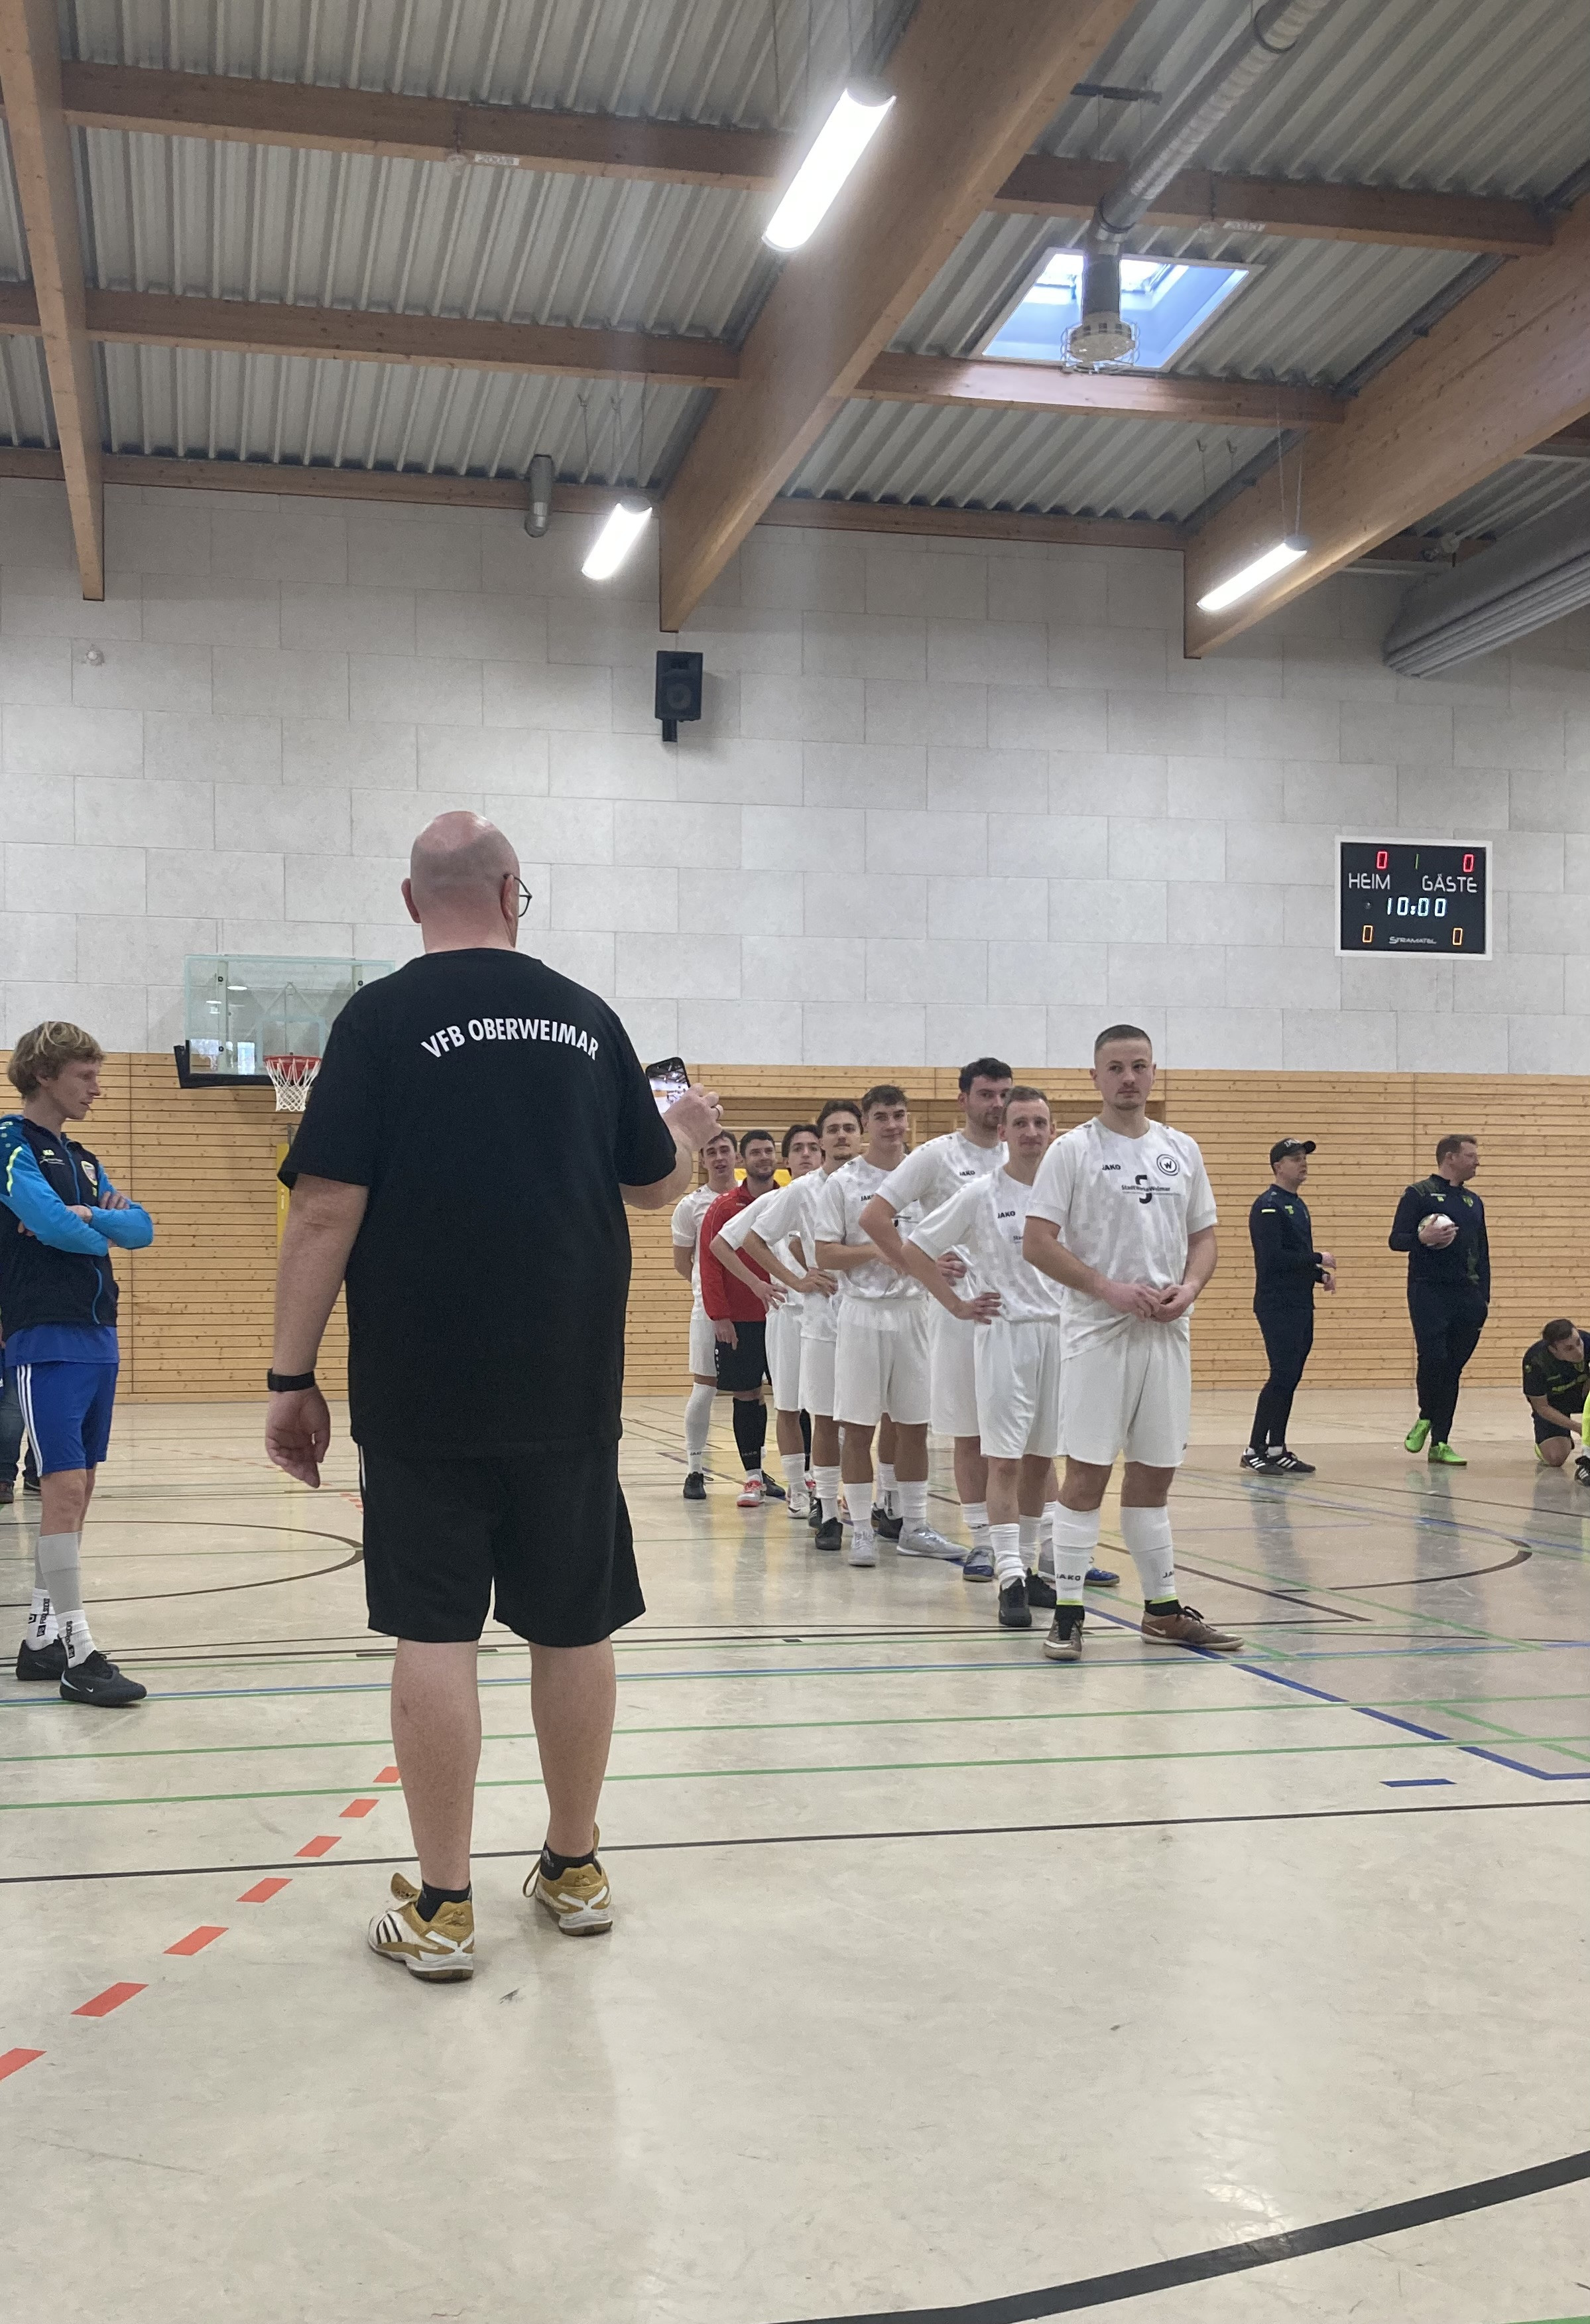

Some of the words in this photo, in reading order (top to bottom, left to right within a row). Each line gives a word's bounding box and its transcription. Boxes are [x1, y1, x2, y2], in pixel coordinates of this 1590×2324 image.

[1376, 851, 1388, 870] 0
[1463, 854, 1475, 873] 0
[1349, 873, 1390, 890] HEIM
[1422, 873, 1478, 893] GÄSTE
[1387, 897, 1446, 917] 10:00
[1362, 925, 1373, 943] 0
[1452, 927, 1463, 946] 0
[420, 1025, 465, 1058] VFB
[468, 1017, 599, 1061] OBERWEIMAR
[997, 1210, 1016, 1219] JAKO
[1162, 1570, 1175, 1579] JA
